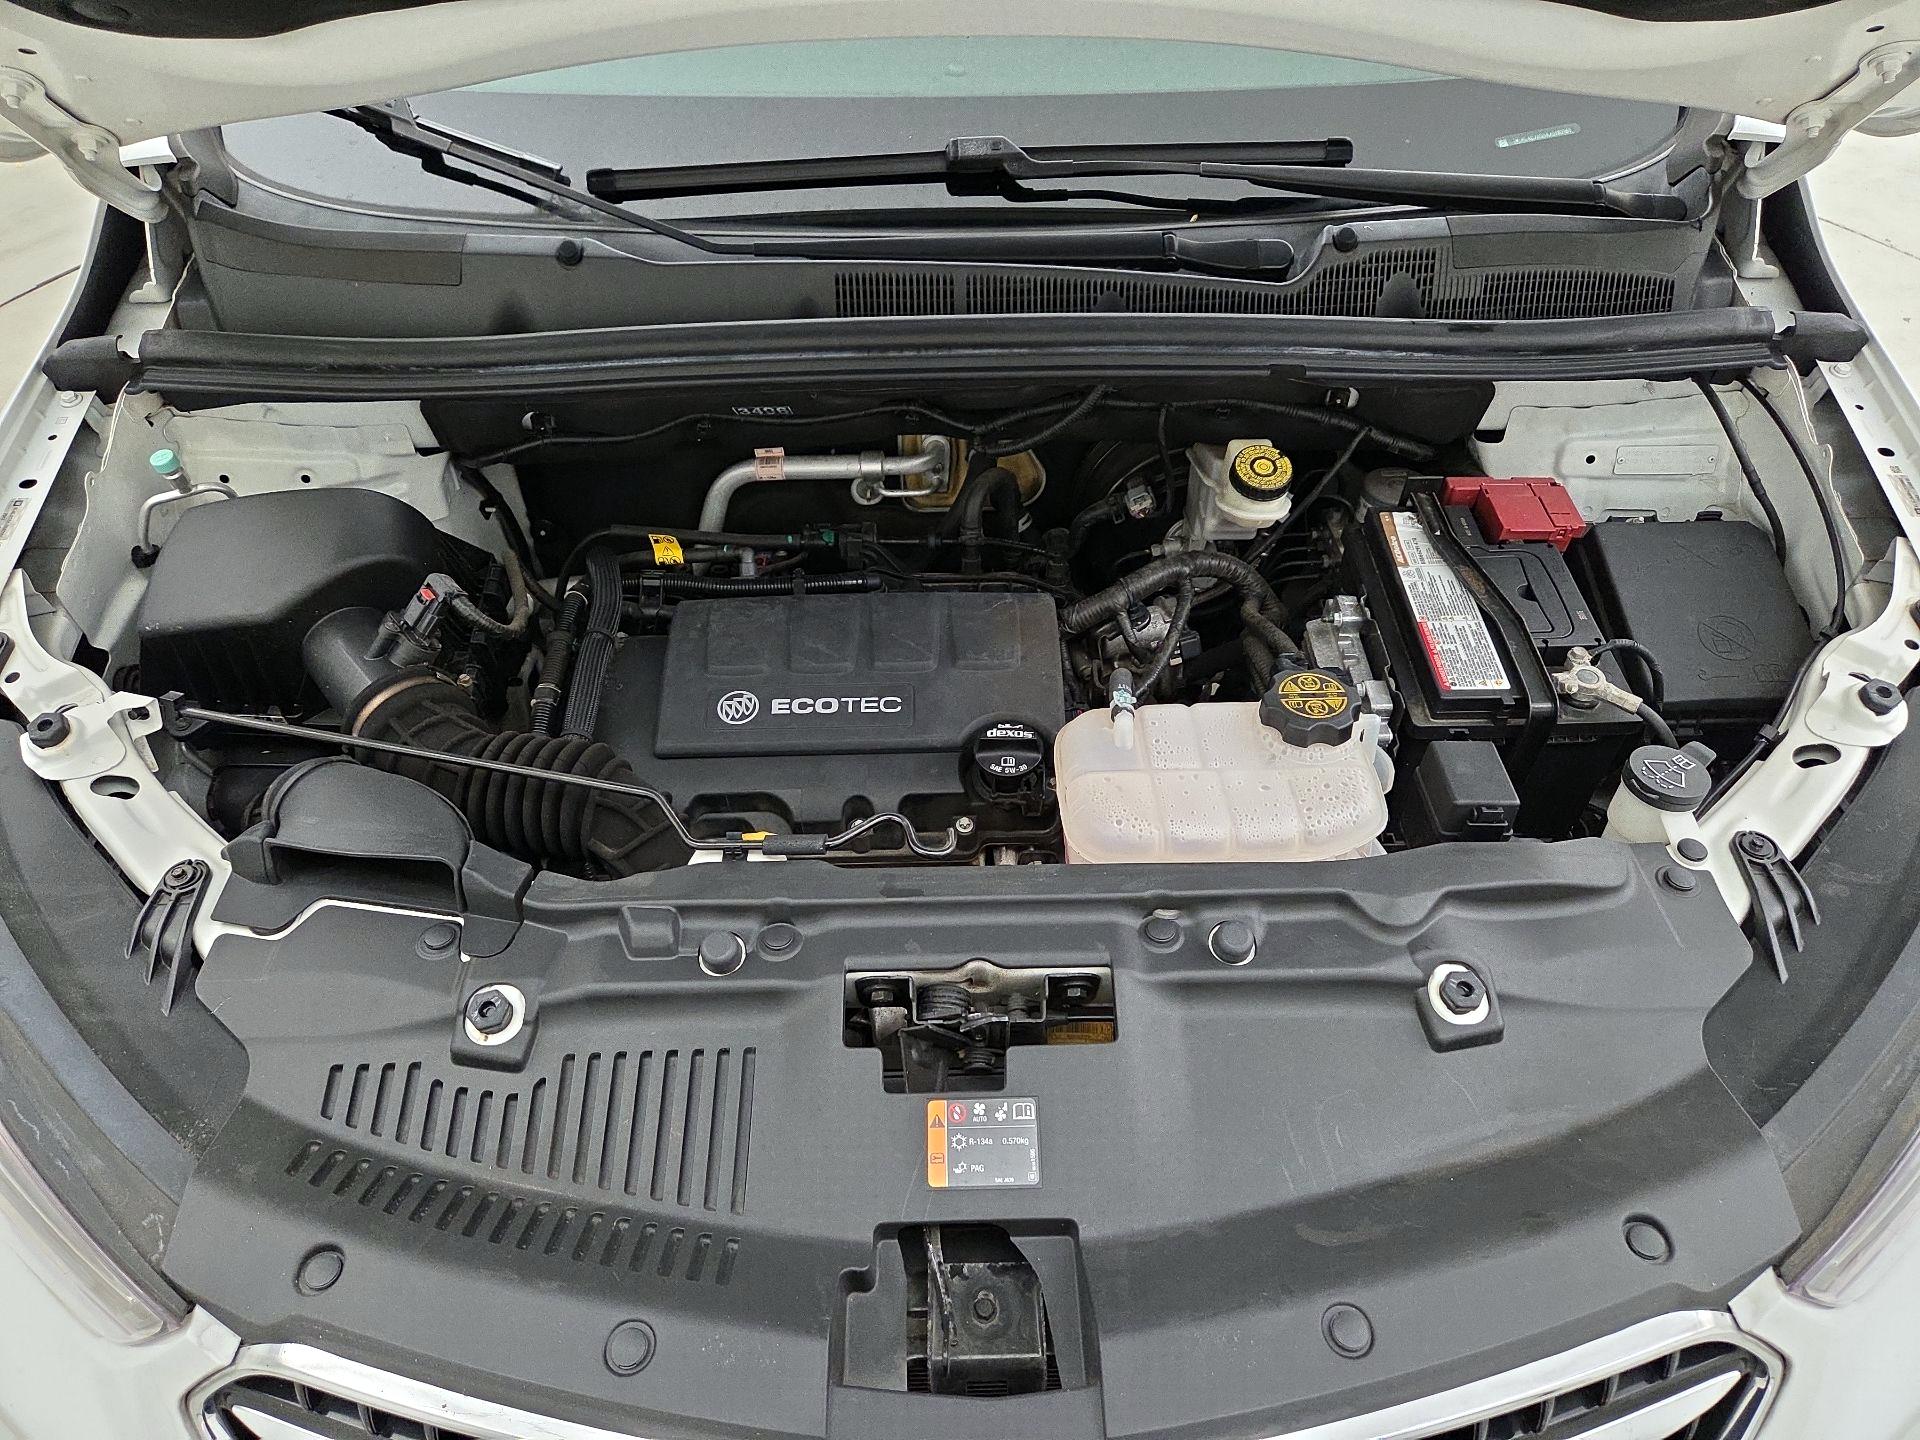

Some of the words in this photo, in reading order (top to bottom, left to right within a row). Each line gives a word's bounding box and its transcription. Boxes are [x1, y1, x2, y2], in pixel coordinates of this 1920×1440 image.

[771, 696, 902, 714] ECOTEC
[986, 728, 1035, 739] dexos
[989, 763, 1003, 773] SAE
[1004, 763, 1028, 774] 5W-30
[1002, 1137, 1029, 1146] 0.570kg
[970, 1164, 985, 1172] PAG
